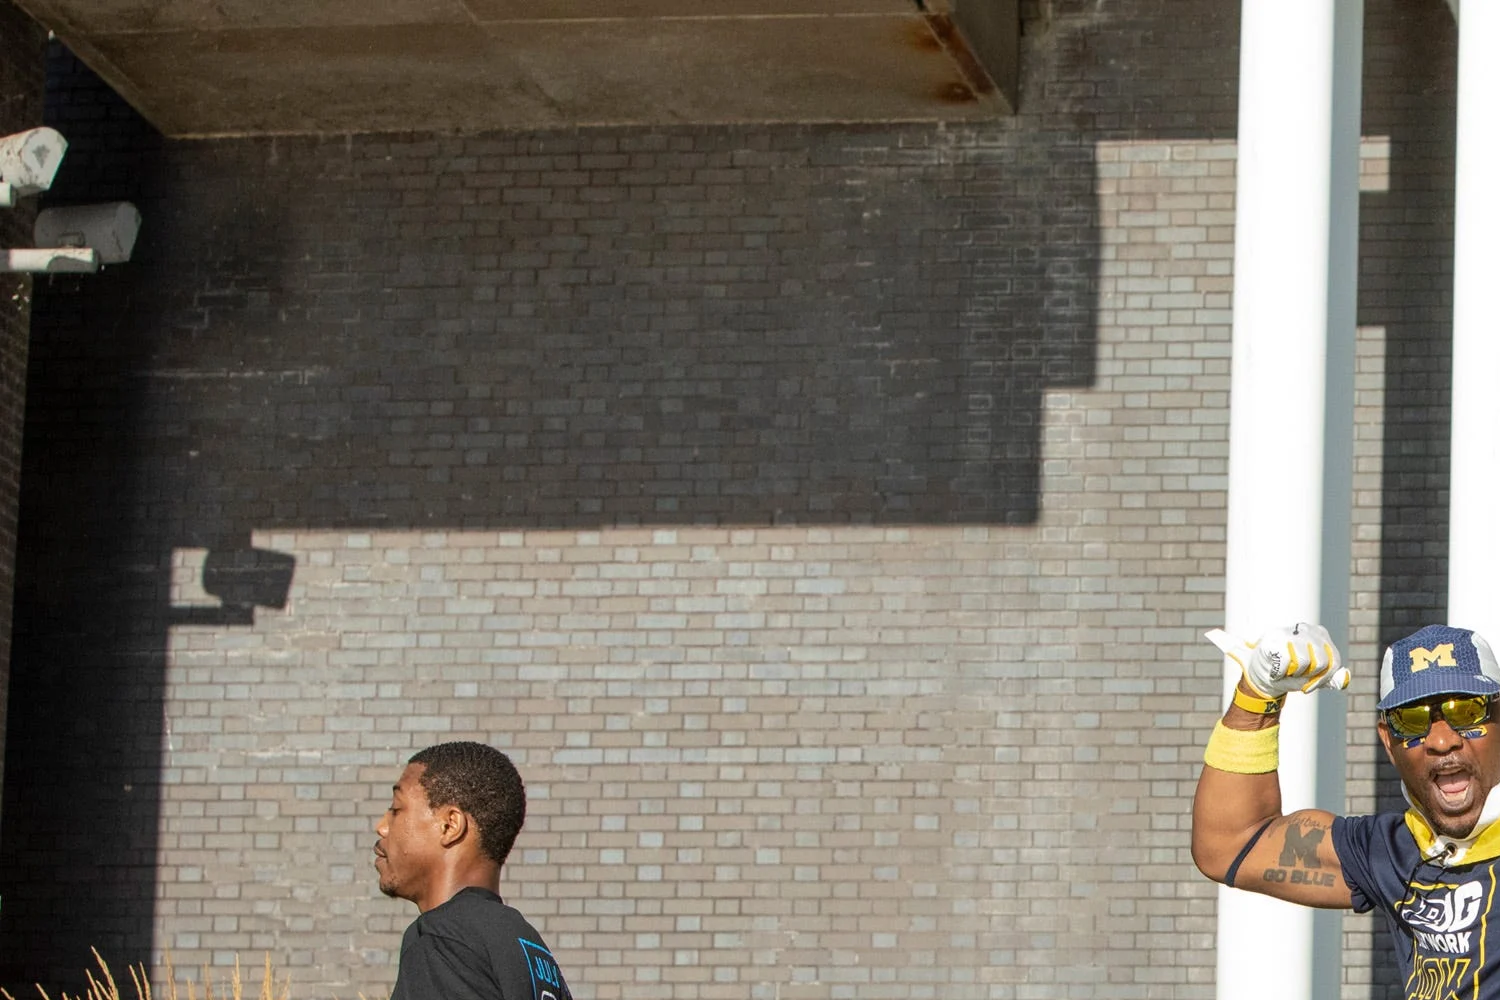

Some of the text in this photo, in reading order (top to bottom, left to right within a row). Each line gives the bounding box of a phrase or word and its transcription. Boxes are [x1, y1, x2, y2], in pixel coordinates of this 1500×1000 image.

[1409, 643, 1457, 673] M
[1279, 823, 1325, 868] M
[1263, 868, 1336, 888] GO BLUE
